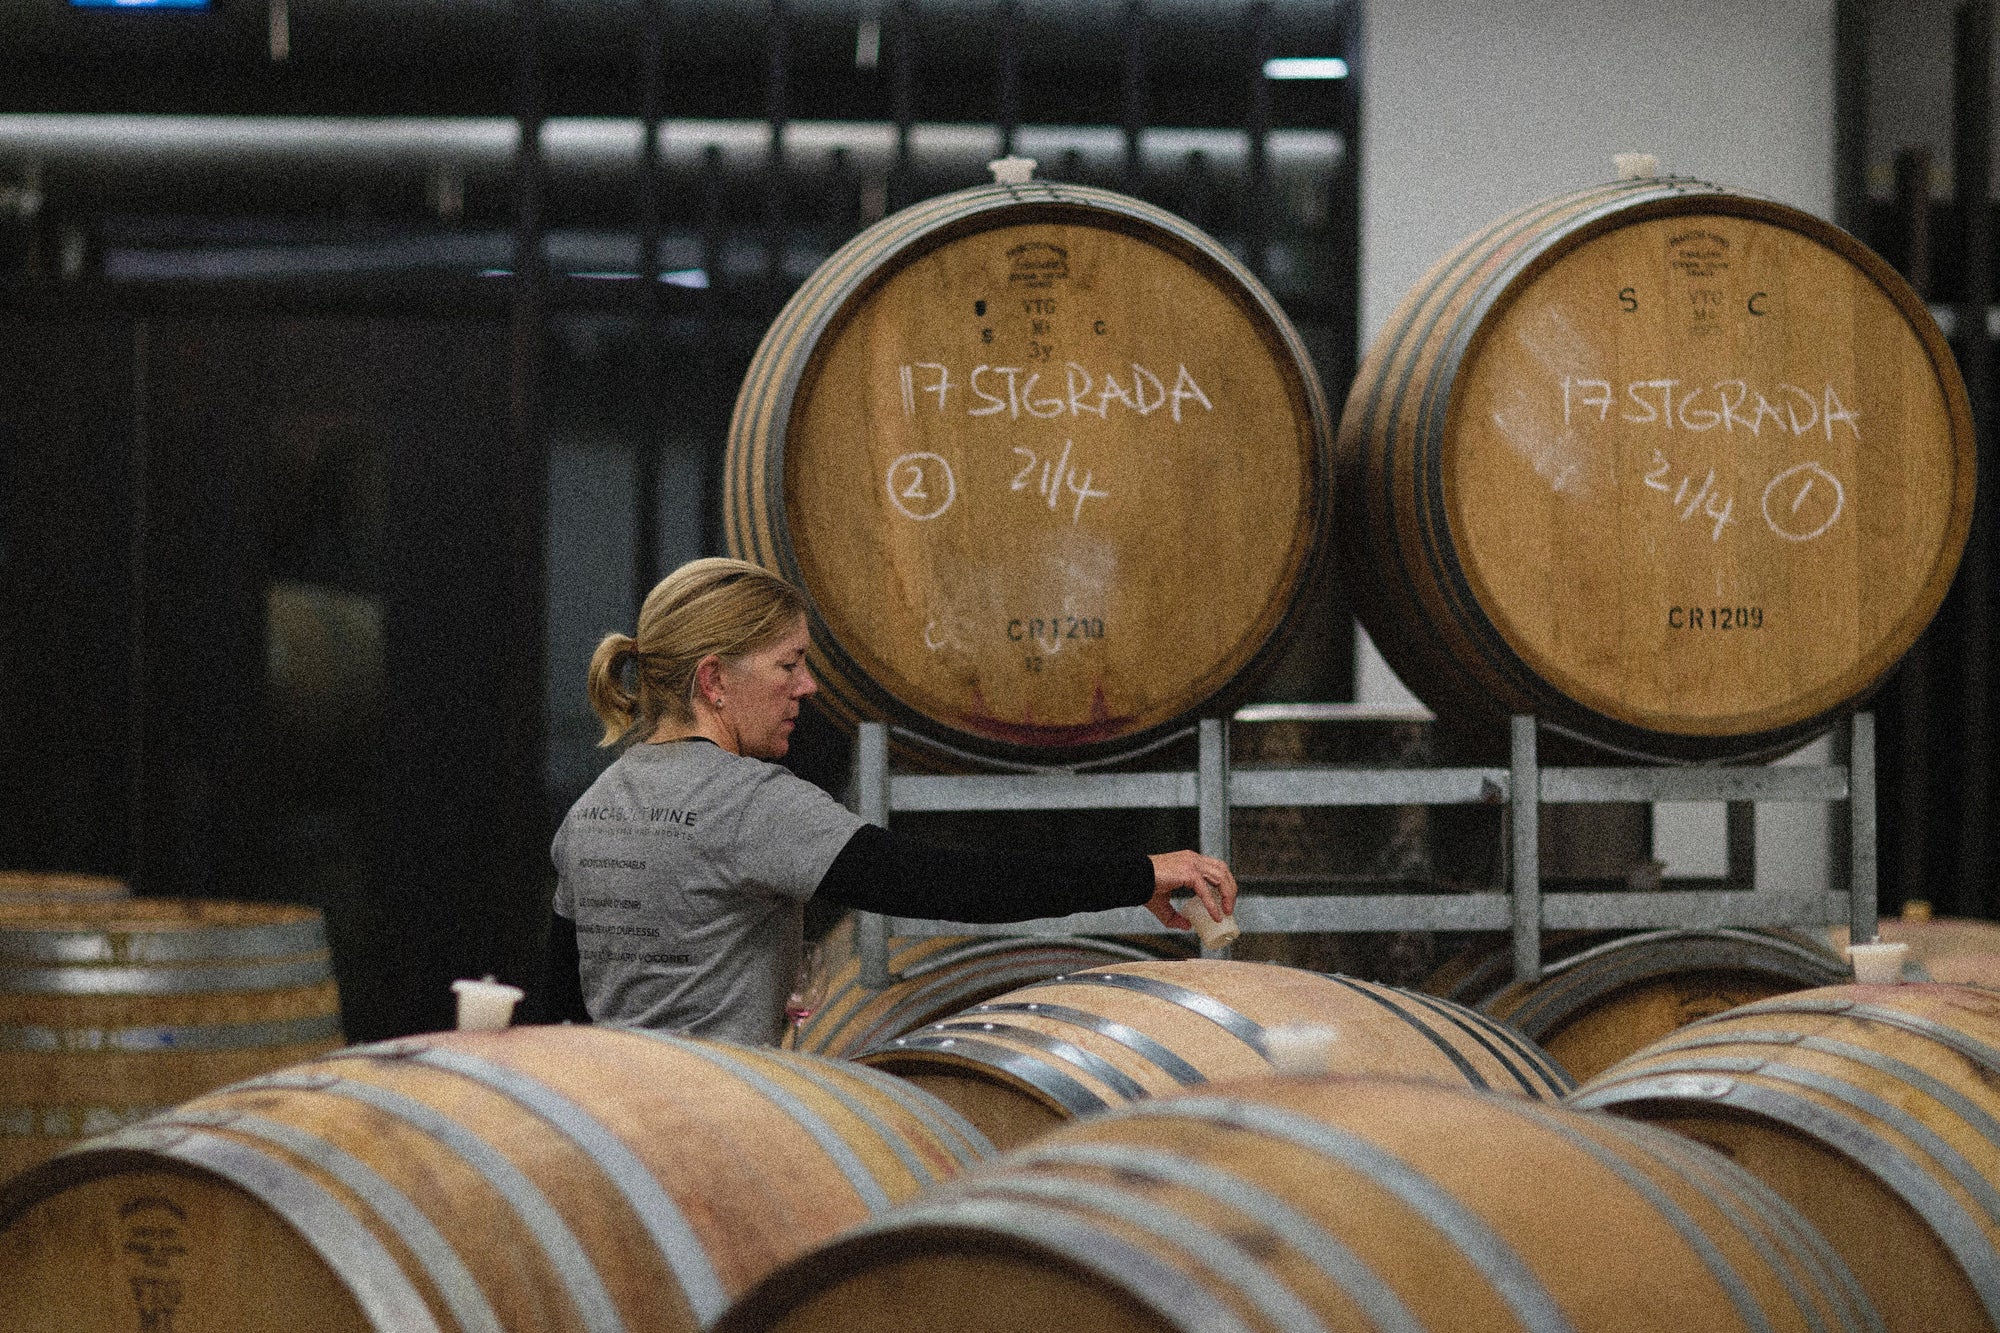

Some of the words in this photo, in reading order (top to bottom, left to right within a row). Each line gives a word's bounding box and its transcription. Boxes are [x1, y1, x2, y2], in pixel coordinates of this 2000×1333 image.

[1617, 287, 1639, 314] S
[1746, 291, 1768, 317] C
[1093, 319, 1107, 336] C
[899, 361, 951, 417] 17
[1559, 375, 1616, 426] 17
[1006, 615, 1105, 642] CR1210
[1667, 605, 1764, 631] CR1209
[650, 807, 697, 828] WINE
